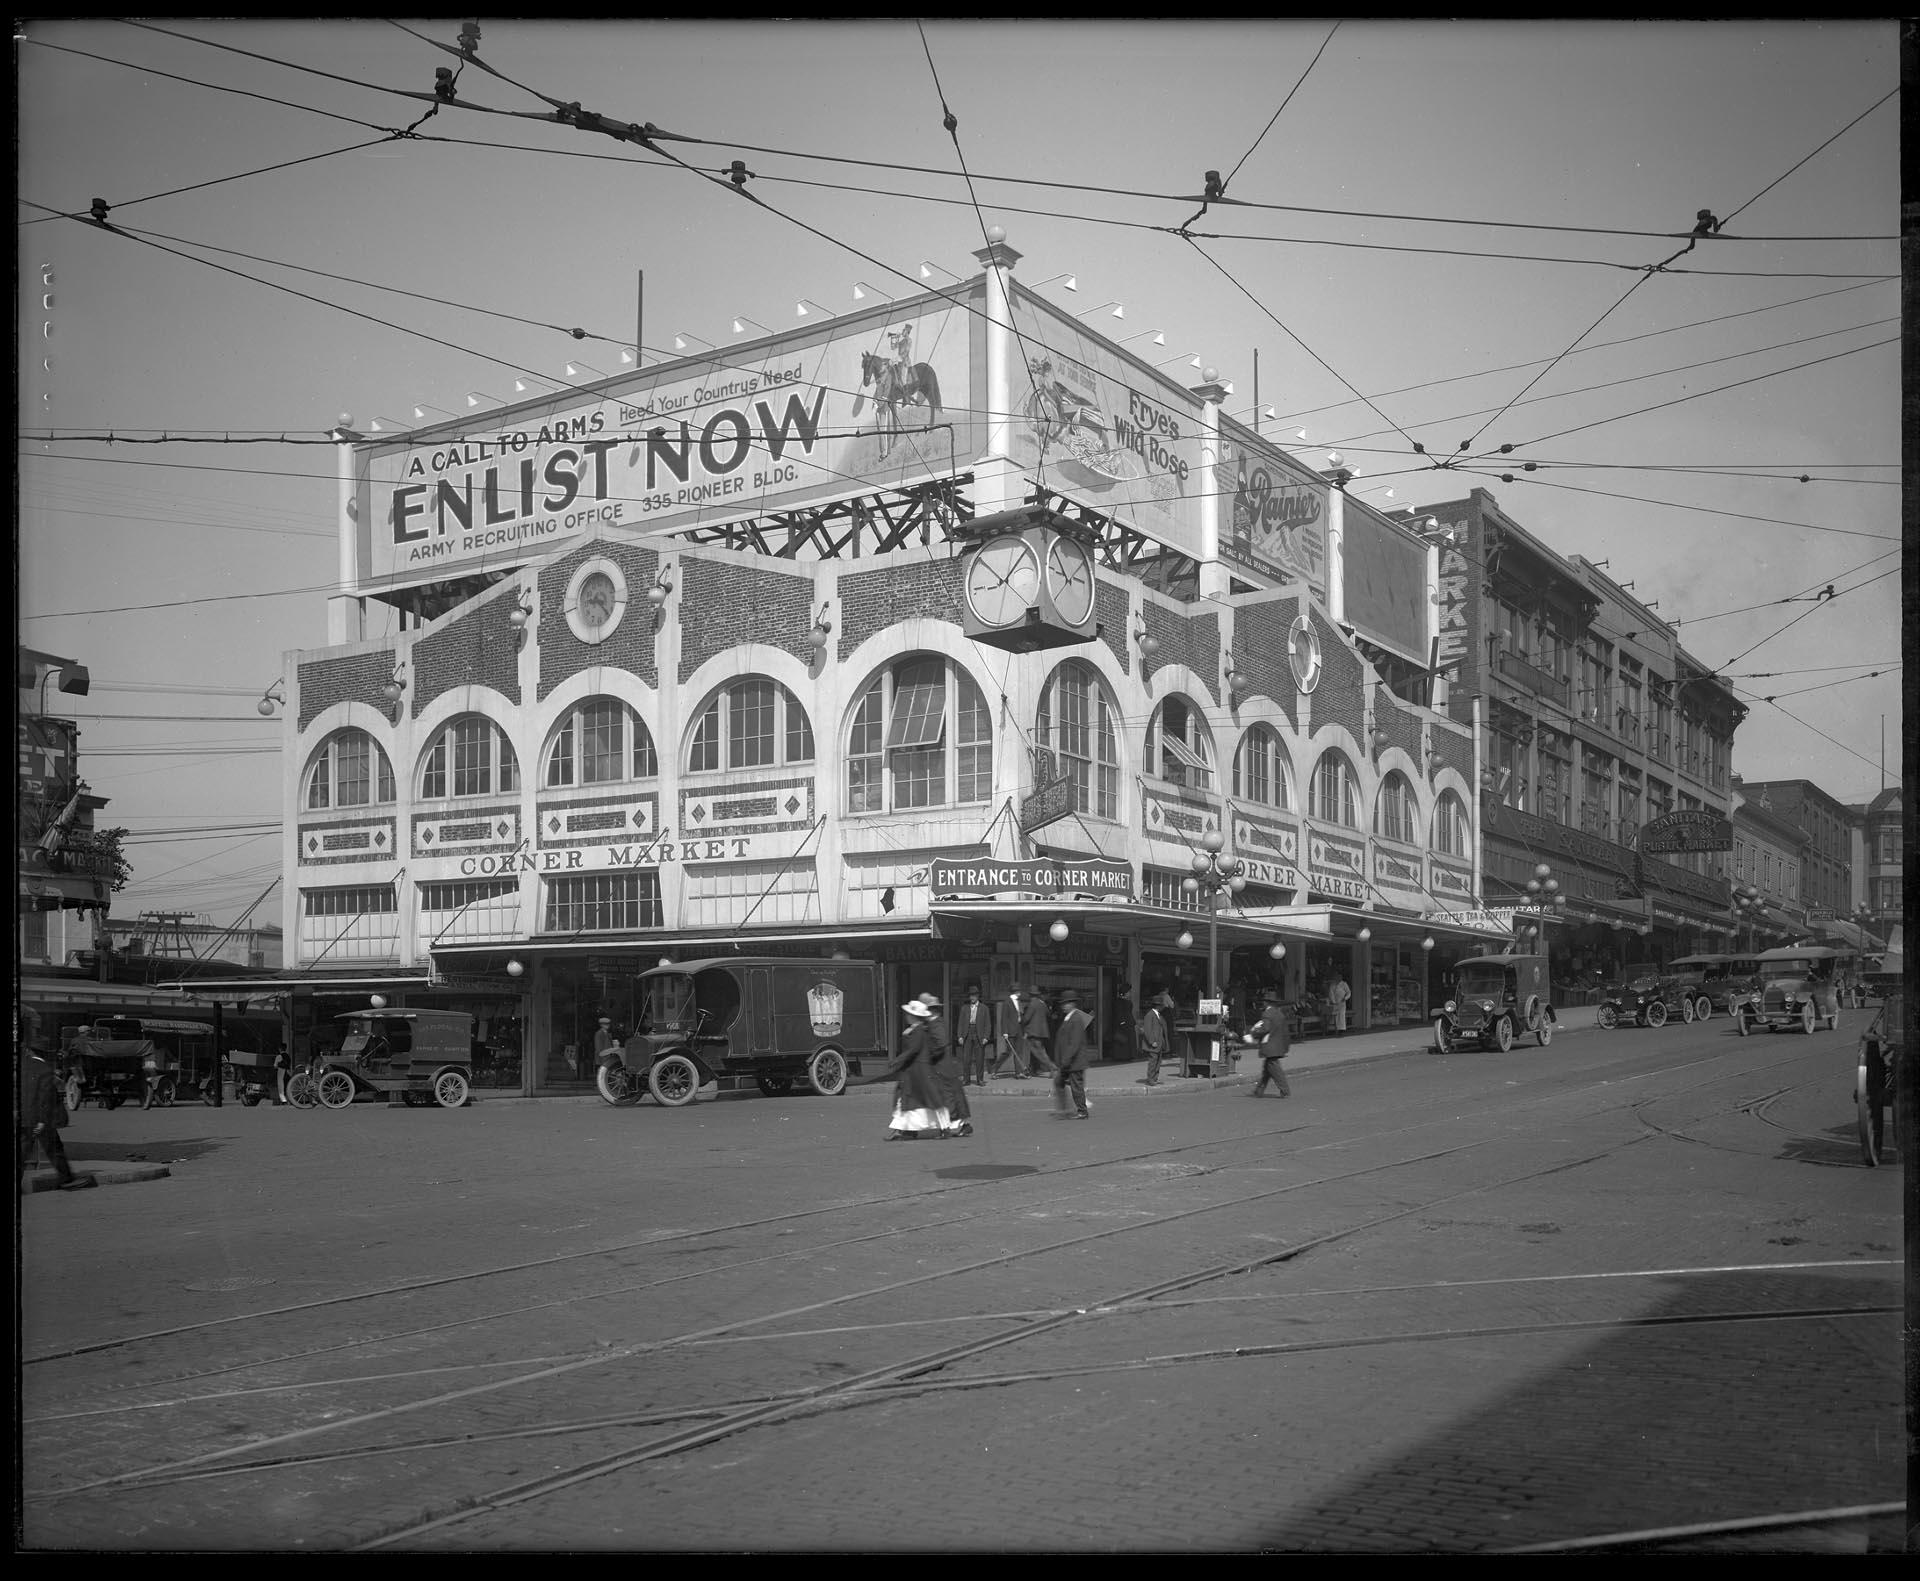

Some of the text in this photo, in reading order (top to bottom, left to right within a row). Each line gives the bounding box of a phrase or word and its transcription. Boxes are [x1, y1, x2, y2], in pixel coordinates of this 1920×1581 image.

[619, 401, 654, 422] Heed
[658, 391, 689, 412] Your
[763, 364, 802, 386] Need
[1129, 391, 1179, 440] Frye's
[391, 385, 828, 545] ENLIST NOW
[408, 412, 604, 478] A CALL TO ARMS
[1114, 414, 1144, 456] Wild
[1150, 436, 1189, 481] Rose
[642, 466, 799, 513] 335 PIONEER BLDG.
[1250, 467, 1321, 534] Rainier
[409, 503, 624, 562] ARMY RECRUITING OFFICE
[460, 838, 752, 876] CORNER MARKET
[938, 868, 1130, 889] ENTRANCE TO CORNER MARKET
[1237, 859, 1374, 901] ORNER MARKET
[886, 945, 946, 961] BAKERY
